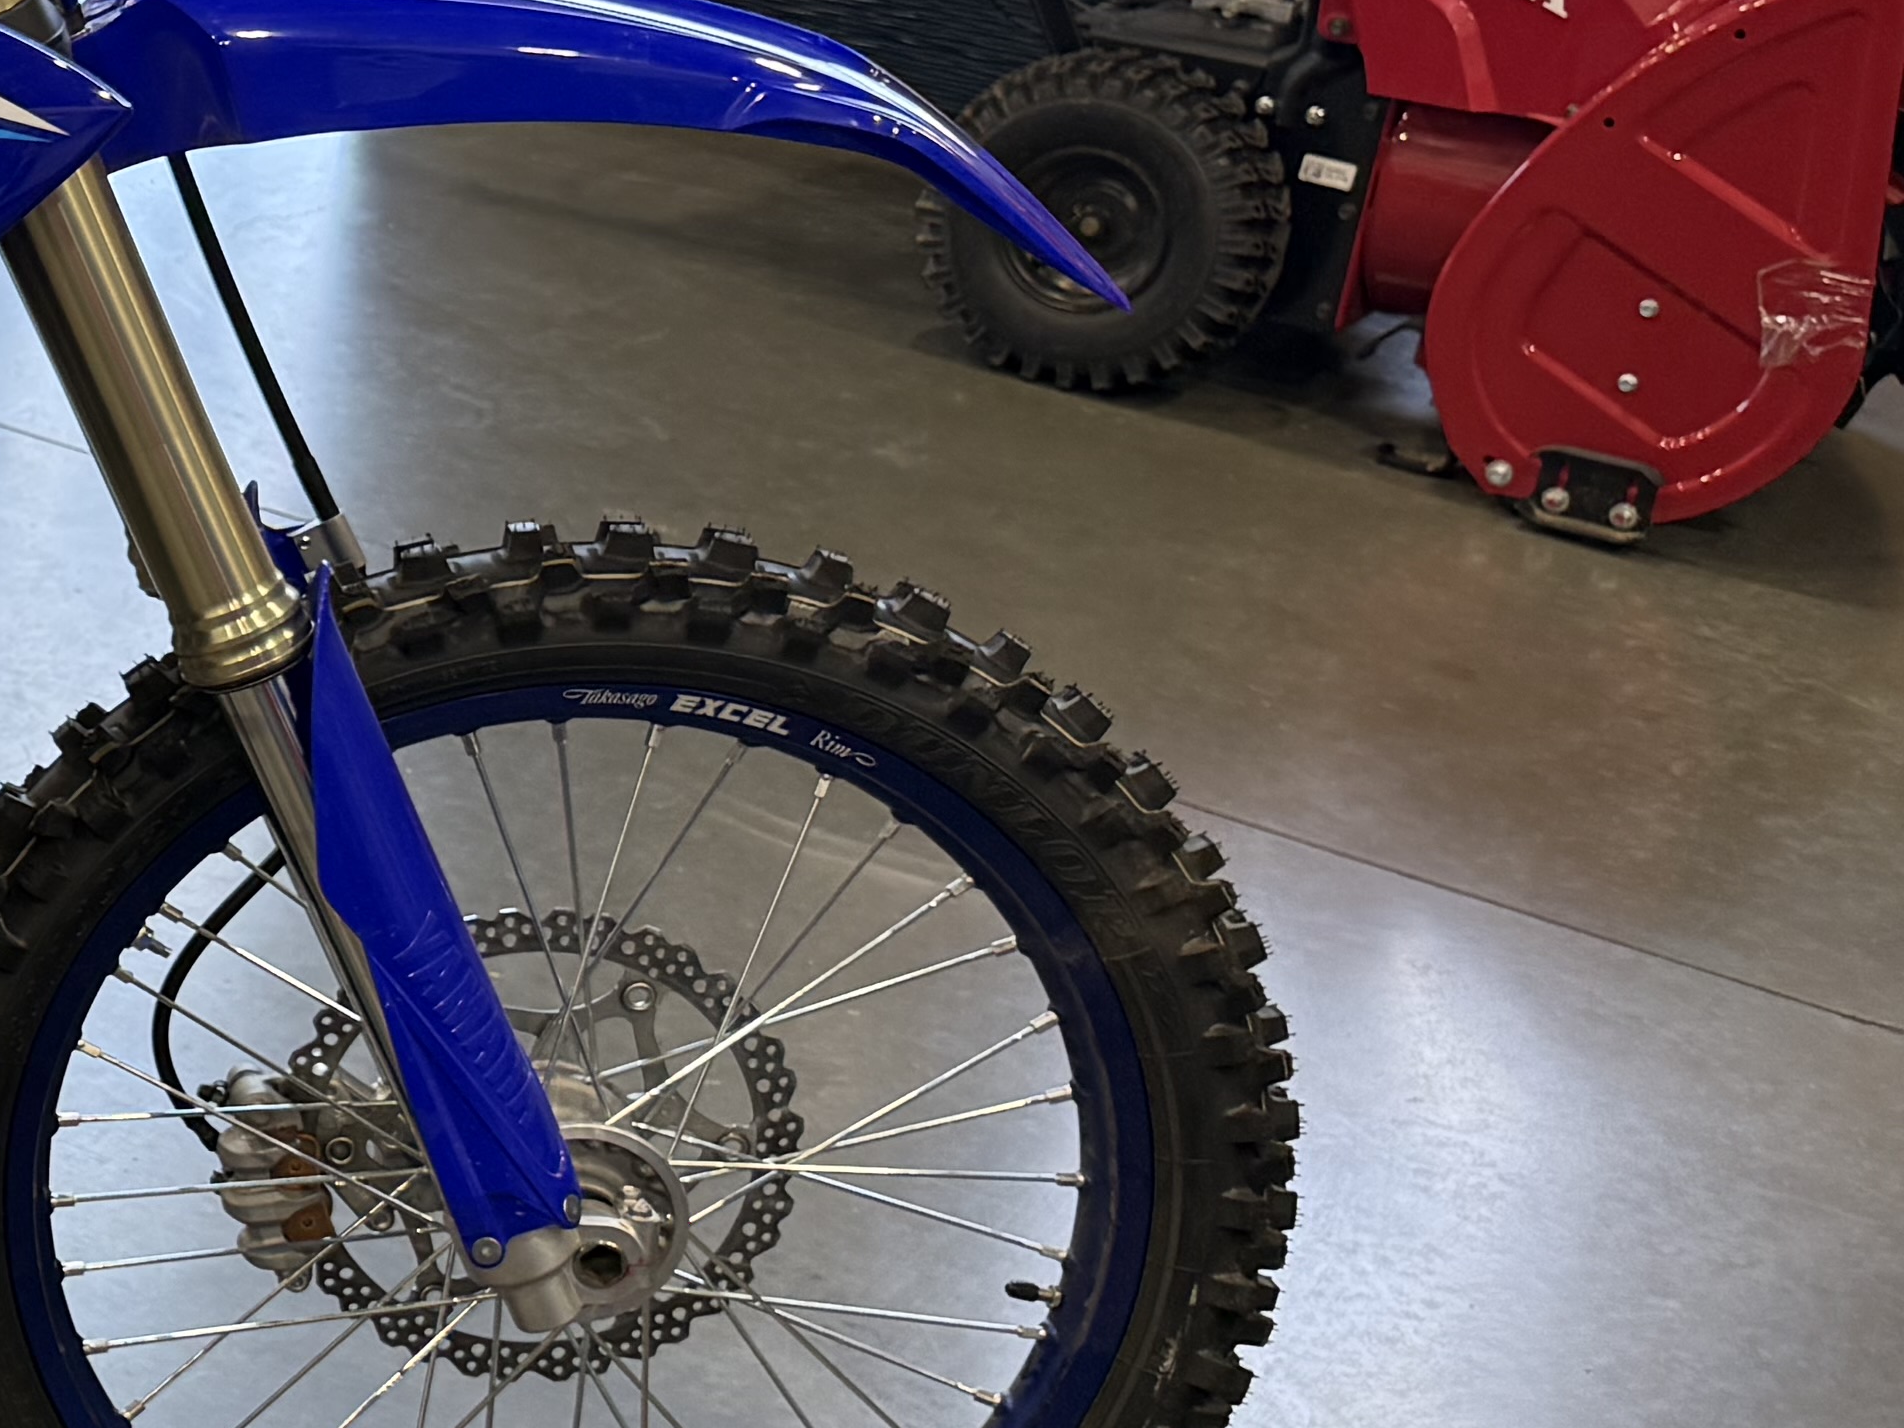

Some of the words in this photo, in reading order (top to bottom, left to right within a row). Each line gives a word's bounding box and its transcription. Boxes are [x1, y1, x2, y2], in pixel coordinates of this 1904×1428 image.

[562, 688, 659, 709] Takasago
[669, 694, 791, 736] EXCEL
[810, 729, 877, 768] Rim
